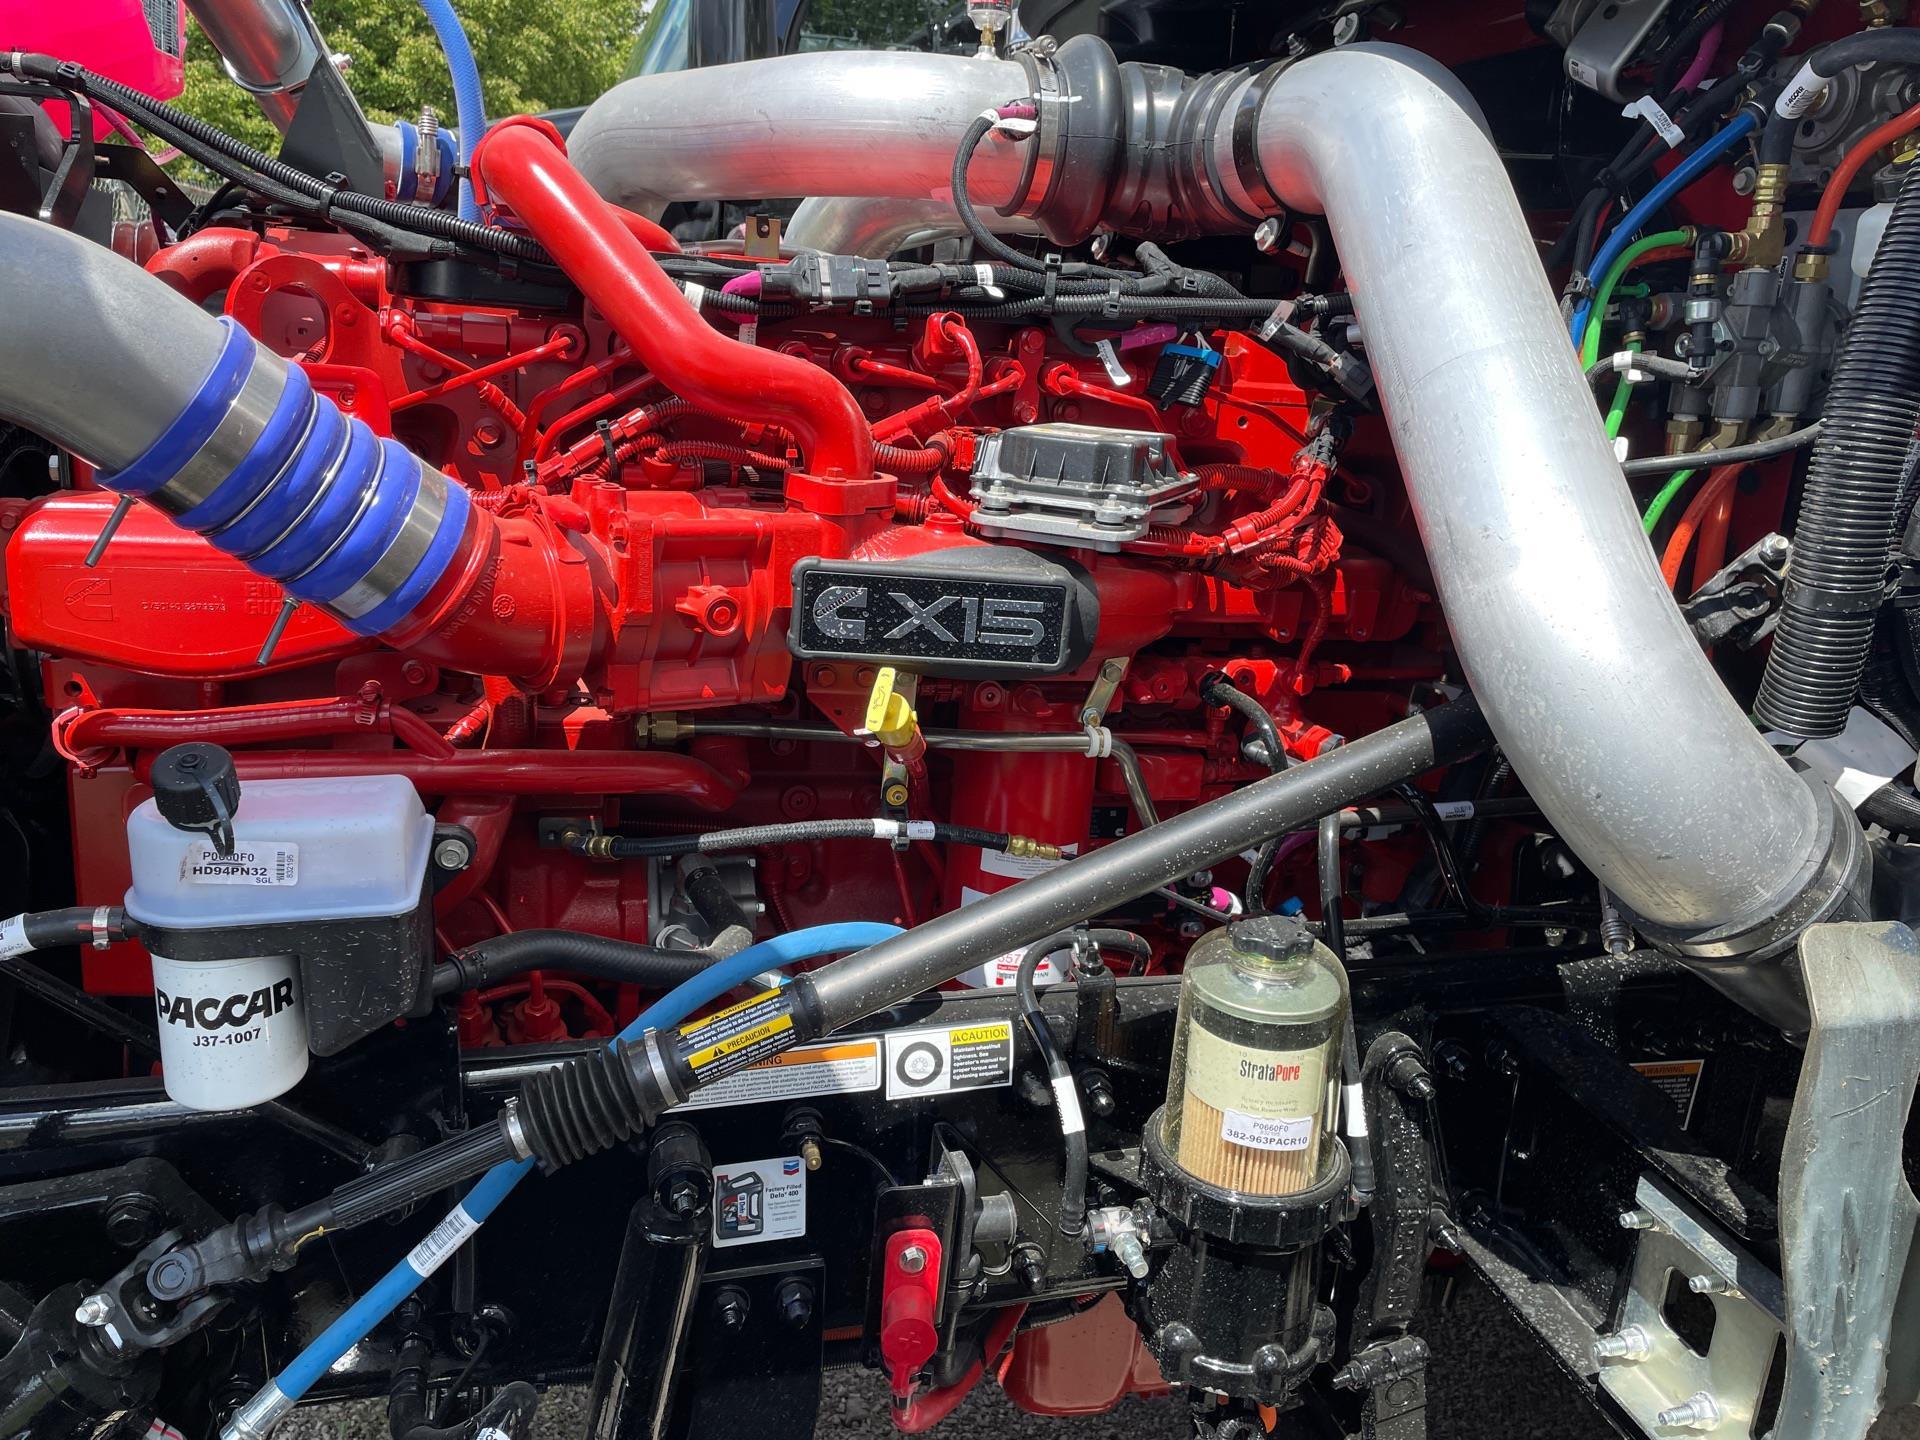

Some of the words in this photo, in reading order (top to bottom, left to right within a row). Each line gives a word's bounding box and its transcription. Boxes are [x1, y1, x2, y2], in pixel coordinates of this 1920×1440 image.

[883, 592, 1045, 647] X15
[193, 866, 268, 877] HD94PN32
[255, 876, 273, 884] SGL
[157, 977, 295, 1031] PACCAR
[193, 1027, 262, 1048] J37-1007
[726, 1025, 771, 1049] PRECAUCION
[961, 1027, 1008, 1041] CAUTION
[1239, 1059, 1300, 1082] StrataPore
[1226, 1127, 1308, 1146] 382-963PACR10
